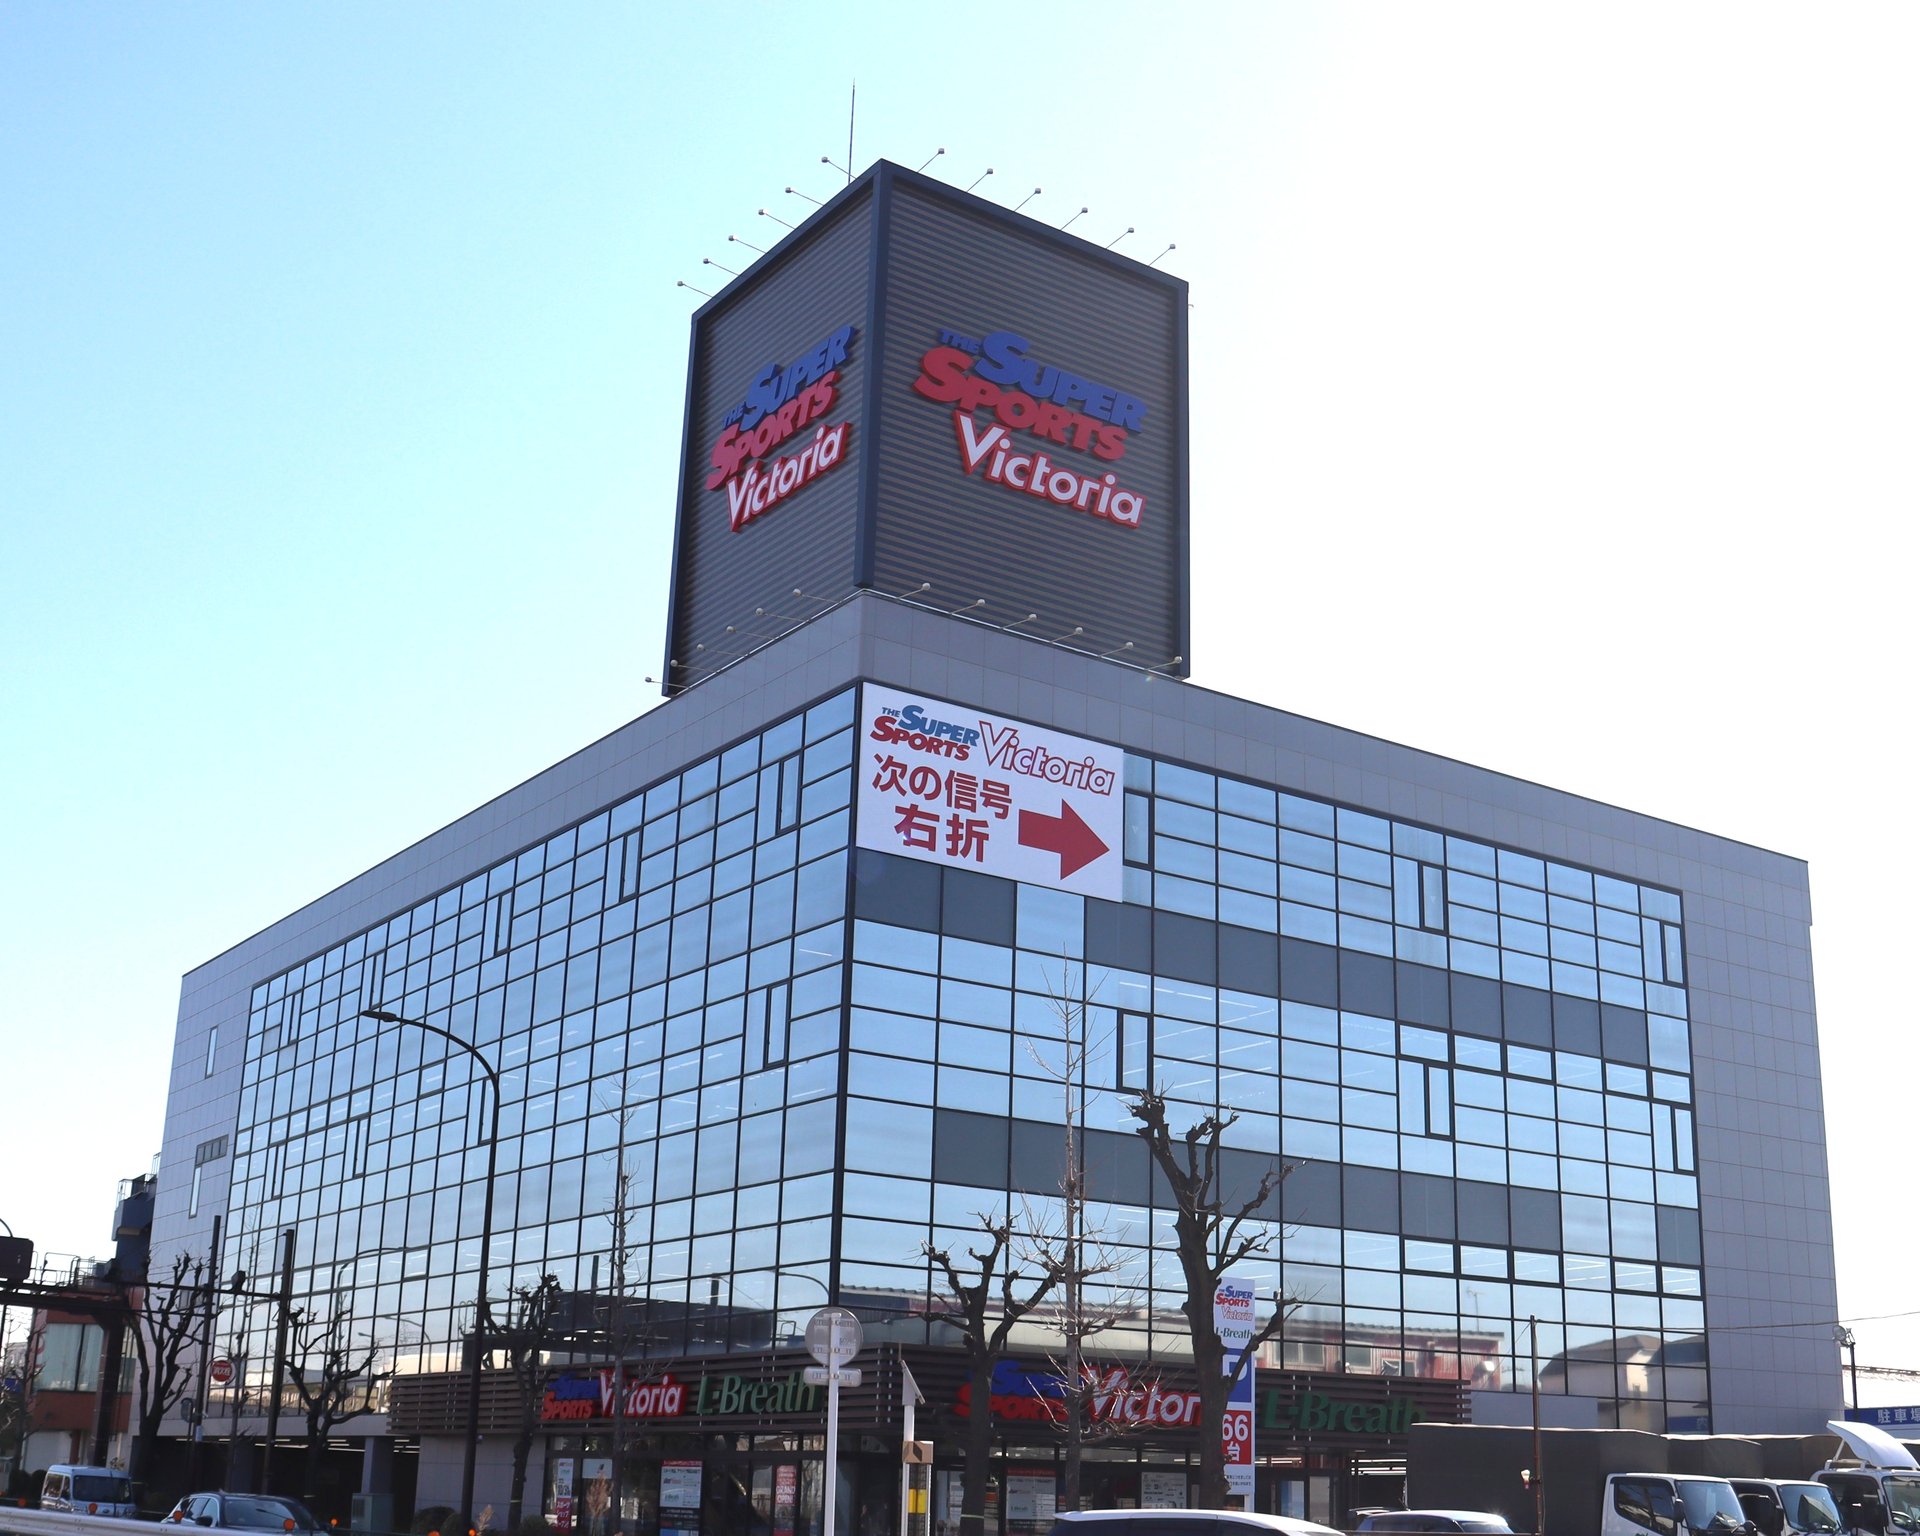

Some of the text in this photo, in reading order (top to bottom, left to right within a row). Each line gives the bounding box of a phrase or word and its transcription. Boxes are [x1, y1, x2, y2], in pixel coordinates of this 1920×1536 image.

[740, 326, 855, 432] SUPER
[912, 345, 1129, 461] SPORTS
[939, 328, 1147, 432] THE SUPER
[706, 371, 841, 490] SPORTS
[726, 421, 852, 533] Victoria
[952, 410, 1145, 529] Victoria
[870, 715, 971, 762] SPORTS
[881, 704, 981, 747] THE SUPER
[978, 719, 1116, 796] Victoria
[872, 753, 1013, 820] 次の信号
[894, 803, 990, 863] 右折
[1215, 1292, 1250, 1308] SPORTS
[1221, 1305, 1254, 1321] Victoria
[1224, 1285, 1253, 1300] SUPER
[541, 1391, 594, 1420] SPORTS
[599, 1370, 685, 1416] Vtoria
[1222, 1413, 1249, 1442] 66
[1225, 1441, 1241, 1462] 台
